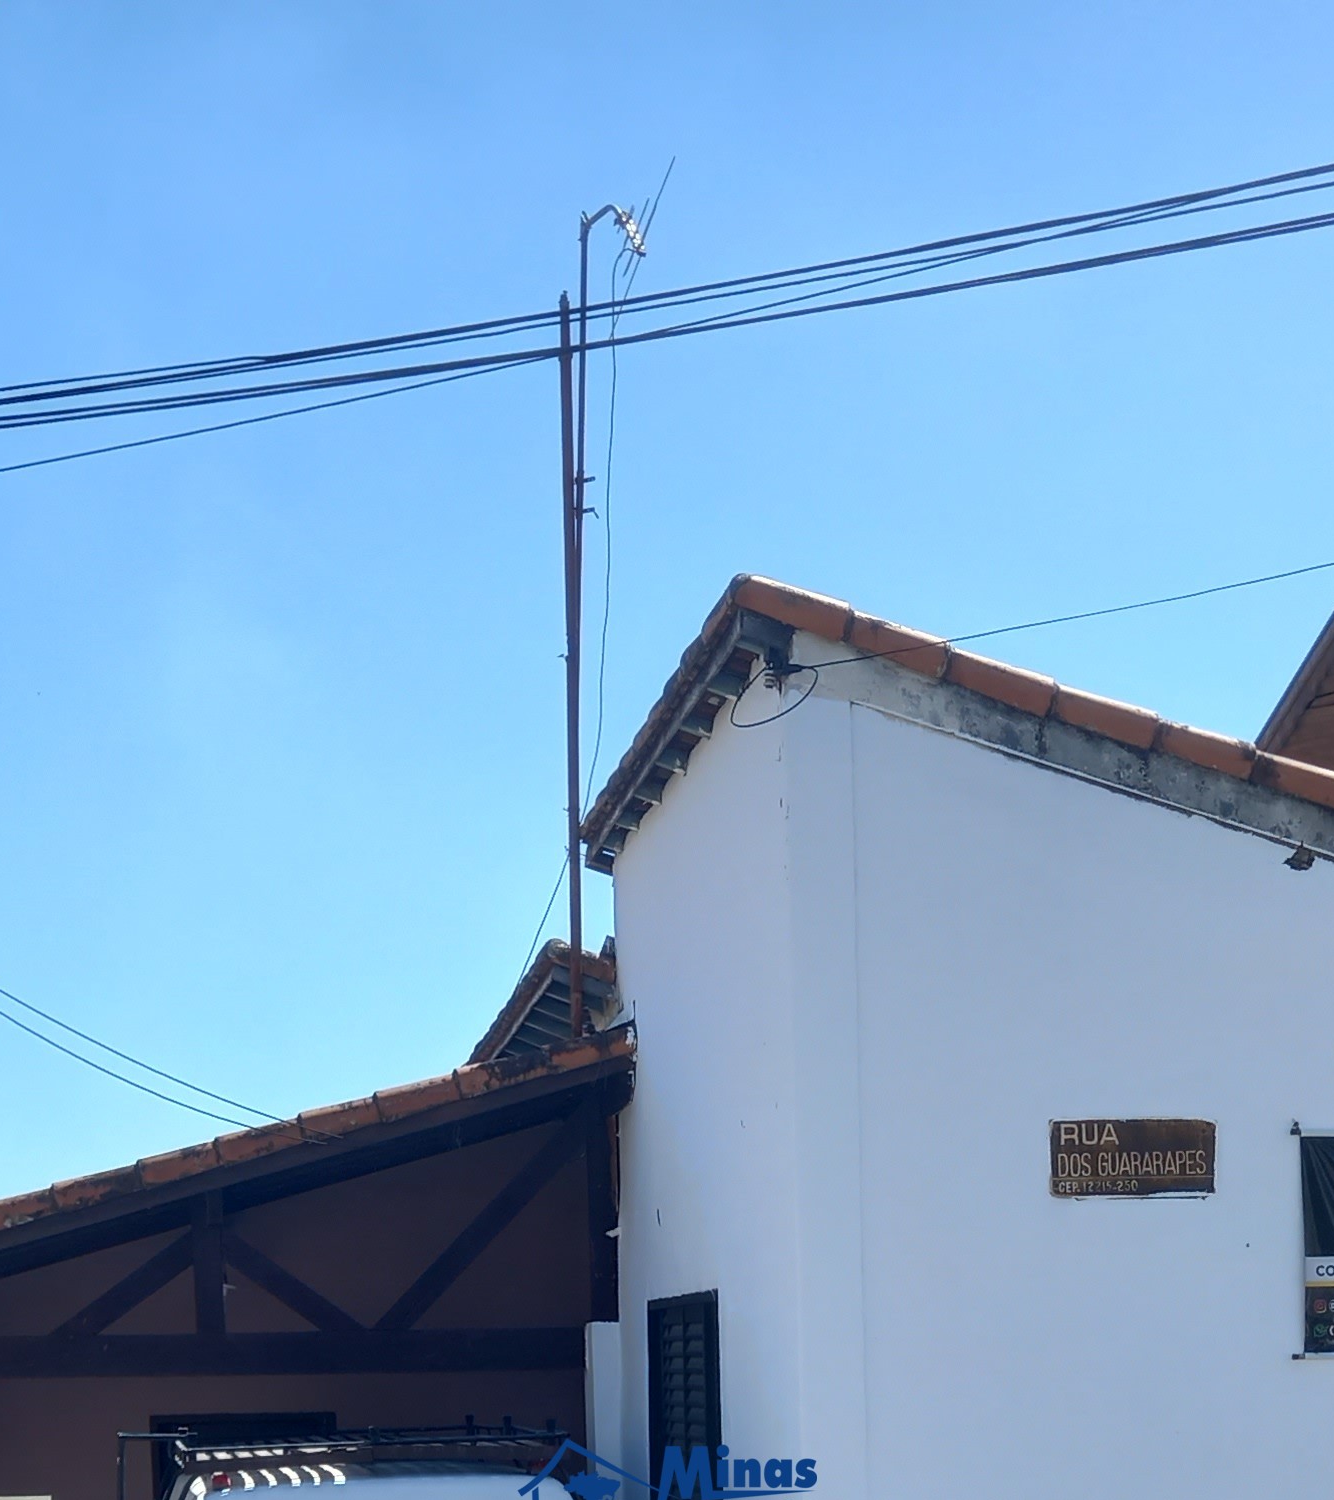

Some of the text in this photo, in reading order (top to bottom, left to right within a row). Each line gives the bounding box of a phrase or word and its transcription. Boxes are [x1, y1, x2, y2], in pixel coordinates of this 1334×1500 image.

[1060, 1123, 1120, 1146] RUA
[1057, 1150, 1207, 1178] DOS GUARARAPES
